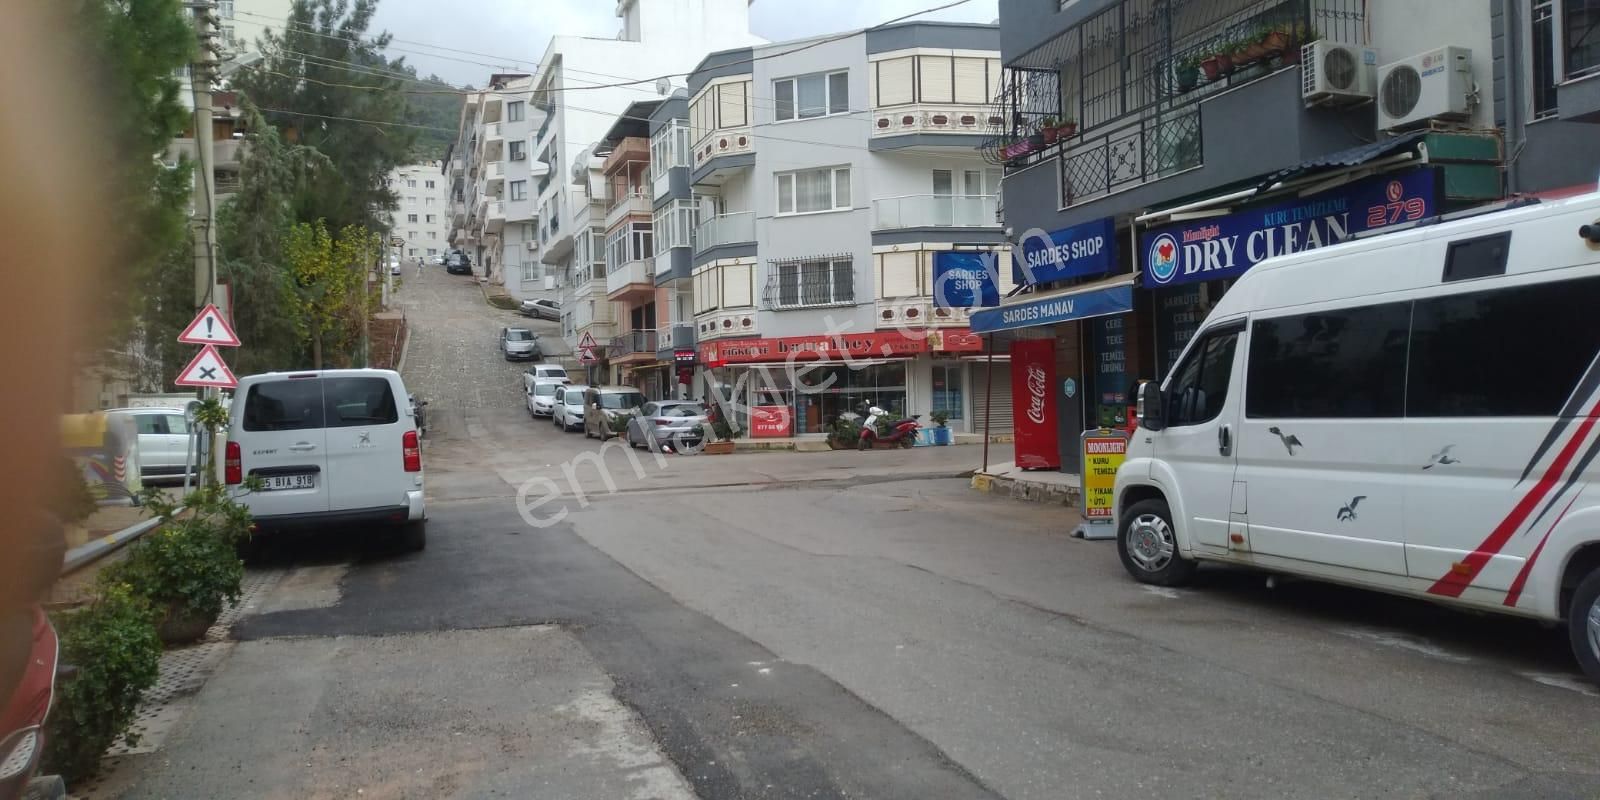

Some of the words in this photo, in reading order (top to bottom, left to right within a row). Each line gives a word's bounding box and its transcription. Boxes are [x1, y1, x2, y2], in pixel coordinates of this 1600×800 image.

[1264, 210, 1288, 227] KURU
[1367, 197, 1425, 228] 279
[1183, 235, 1239, 275] DRY
[1246, 212, 1350, 263] CLEAN
[1027, 243, 1070, 269] SARDES
[1072, 236, 1104, 260] SHOP
[949, 269, 989, 280] SARDES
[955, 280, 983, 290] SHOP
[1003, 305, 1039, 324] SARDES
[1040, 300, 1074, 318] MANAV
[1087, 442, 1125, 453] MOONLIGHT
[275, 477, 291, 487] BIA
[296, 475, 312, 485] 918
